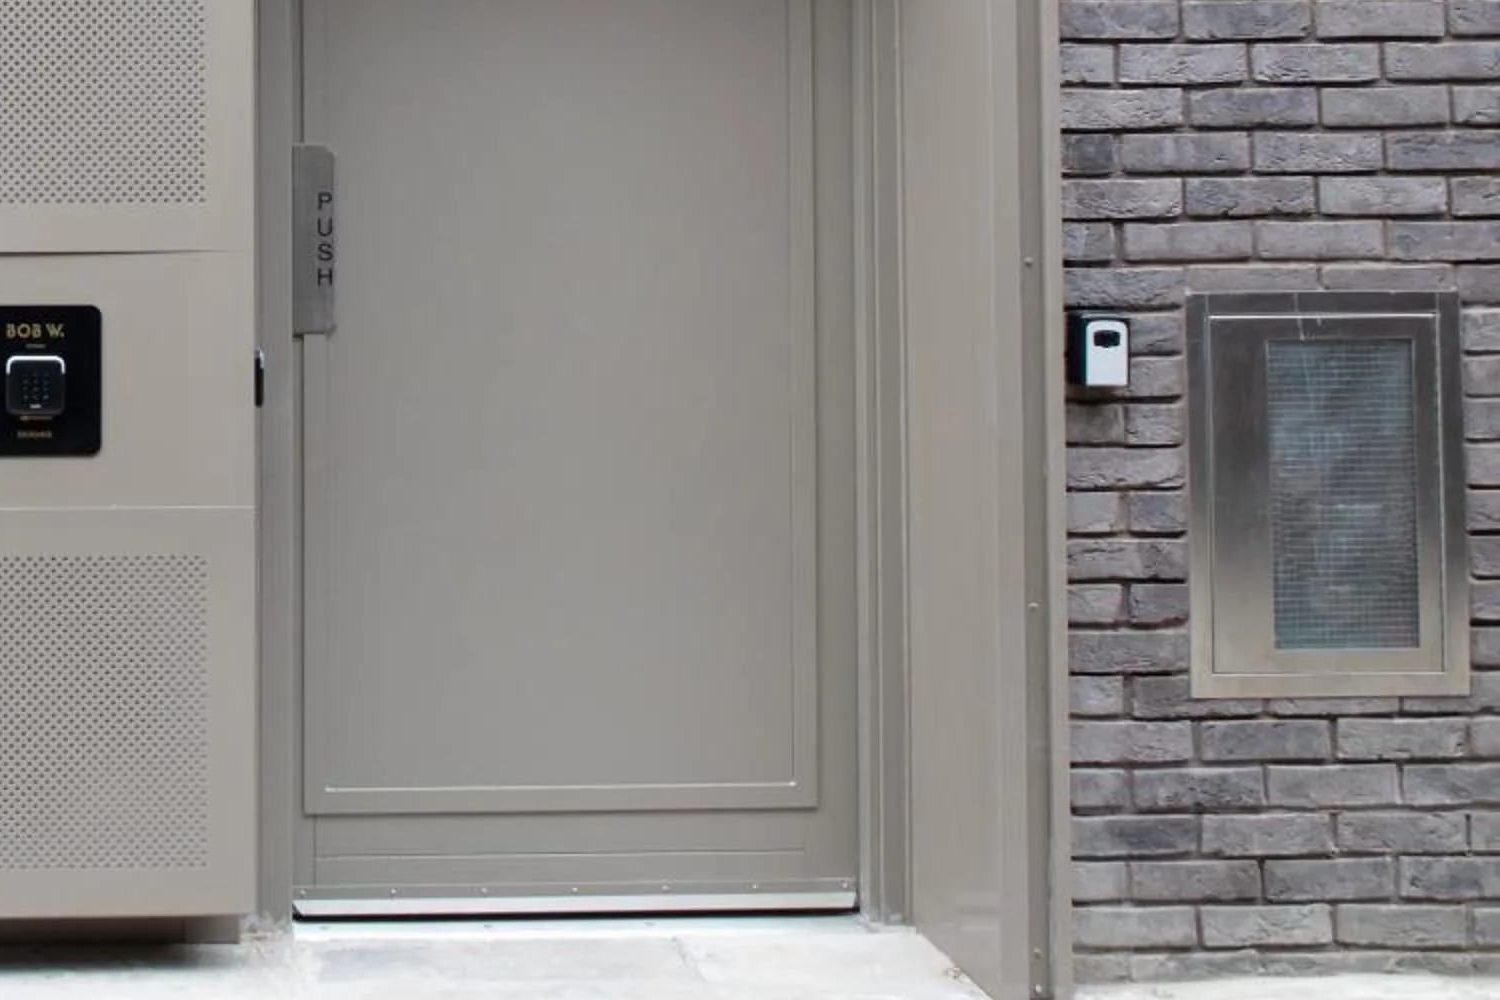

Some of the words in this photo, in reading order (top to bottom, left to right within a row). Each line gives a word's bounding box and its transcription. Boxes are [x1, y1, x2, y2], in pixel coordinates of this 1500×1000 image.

[317, 191, 333, 287] PUSH
[6, 323, 42, 339] BOB
[45, 323, 65, 339] W.
